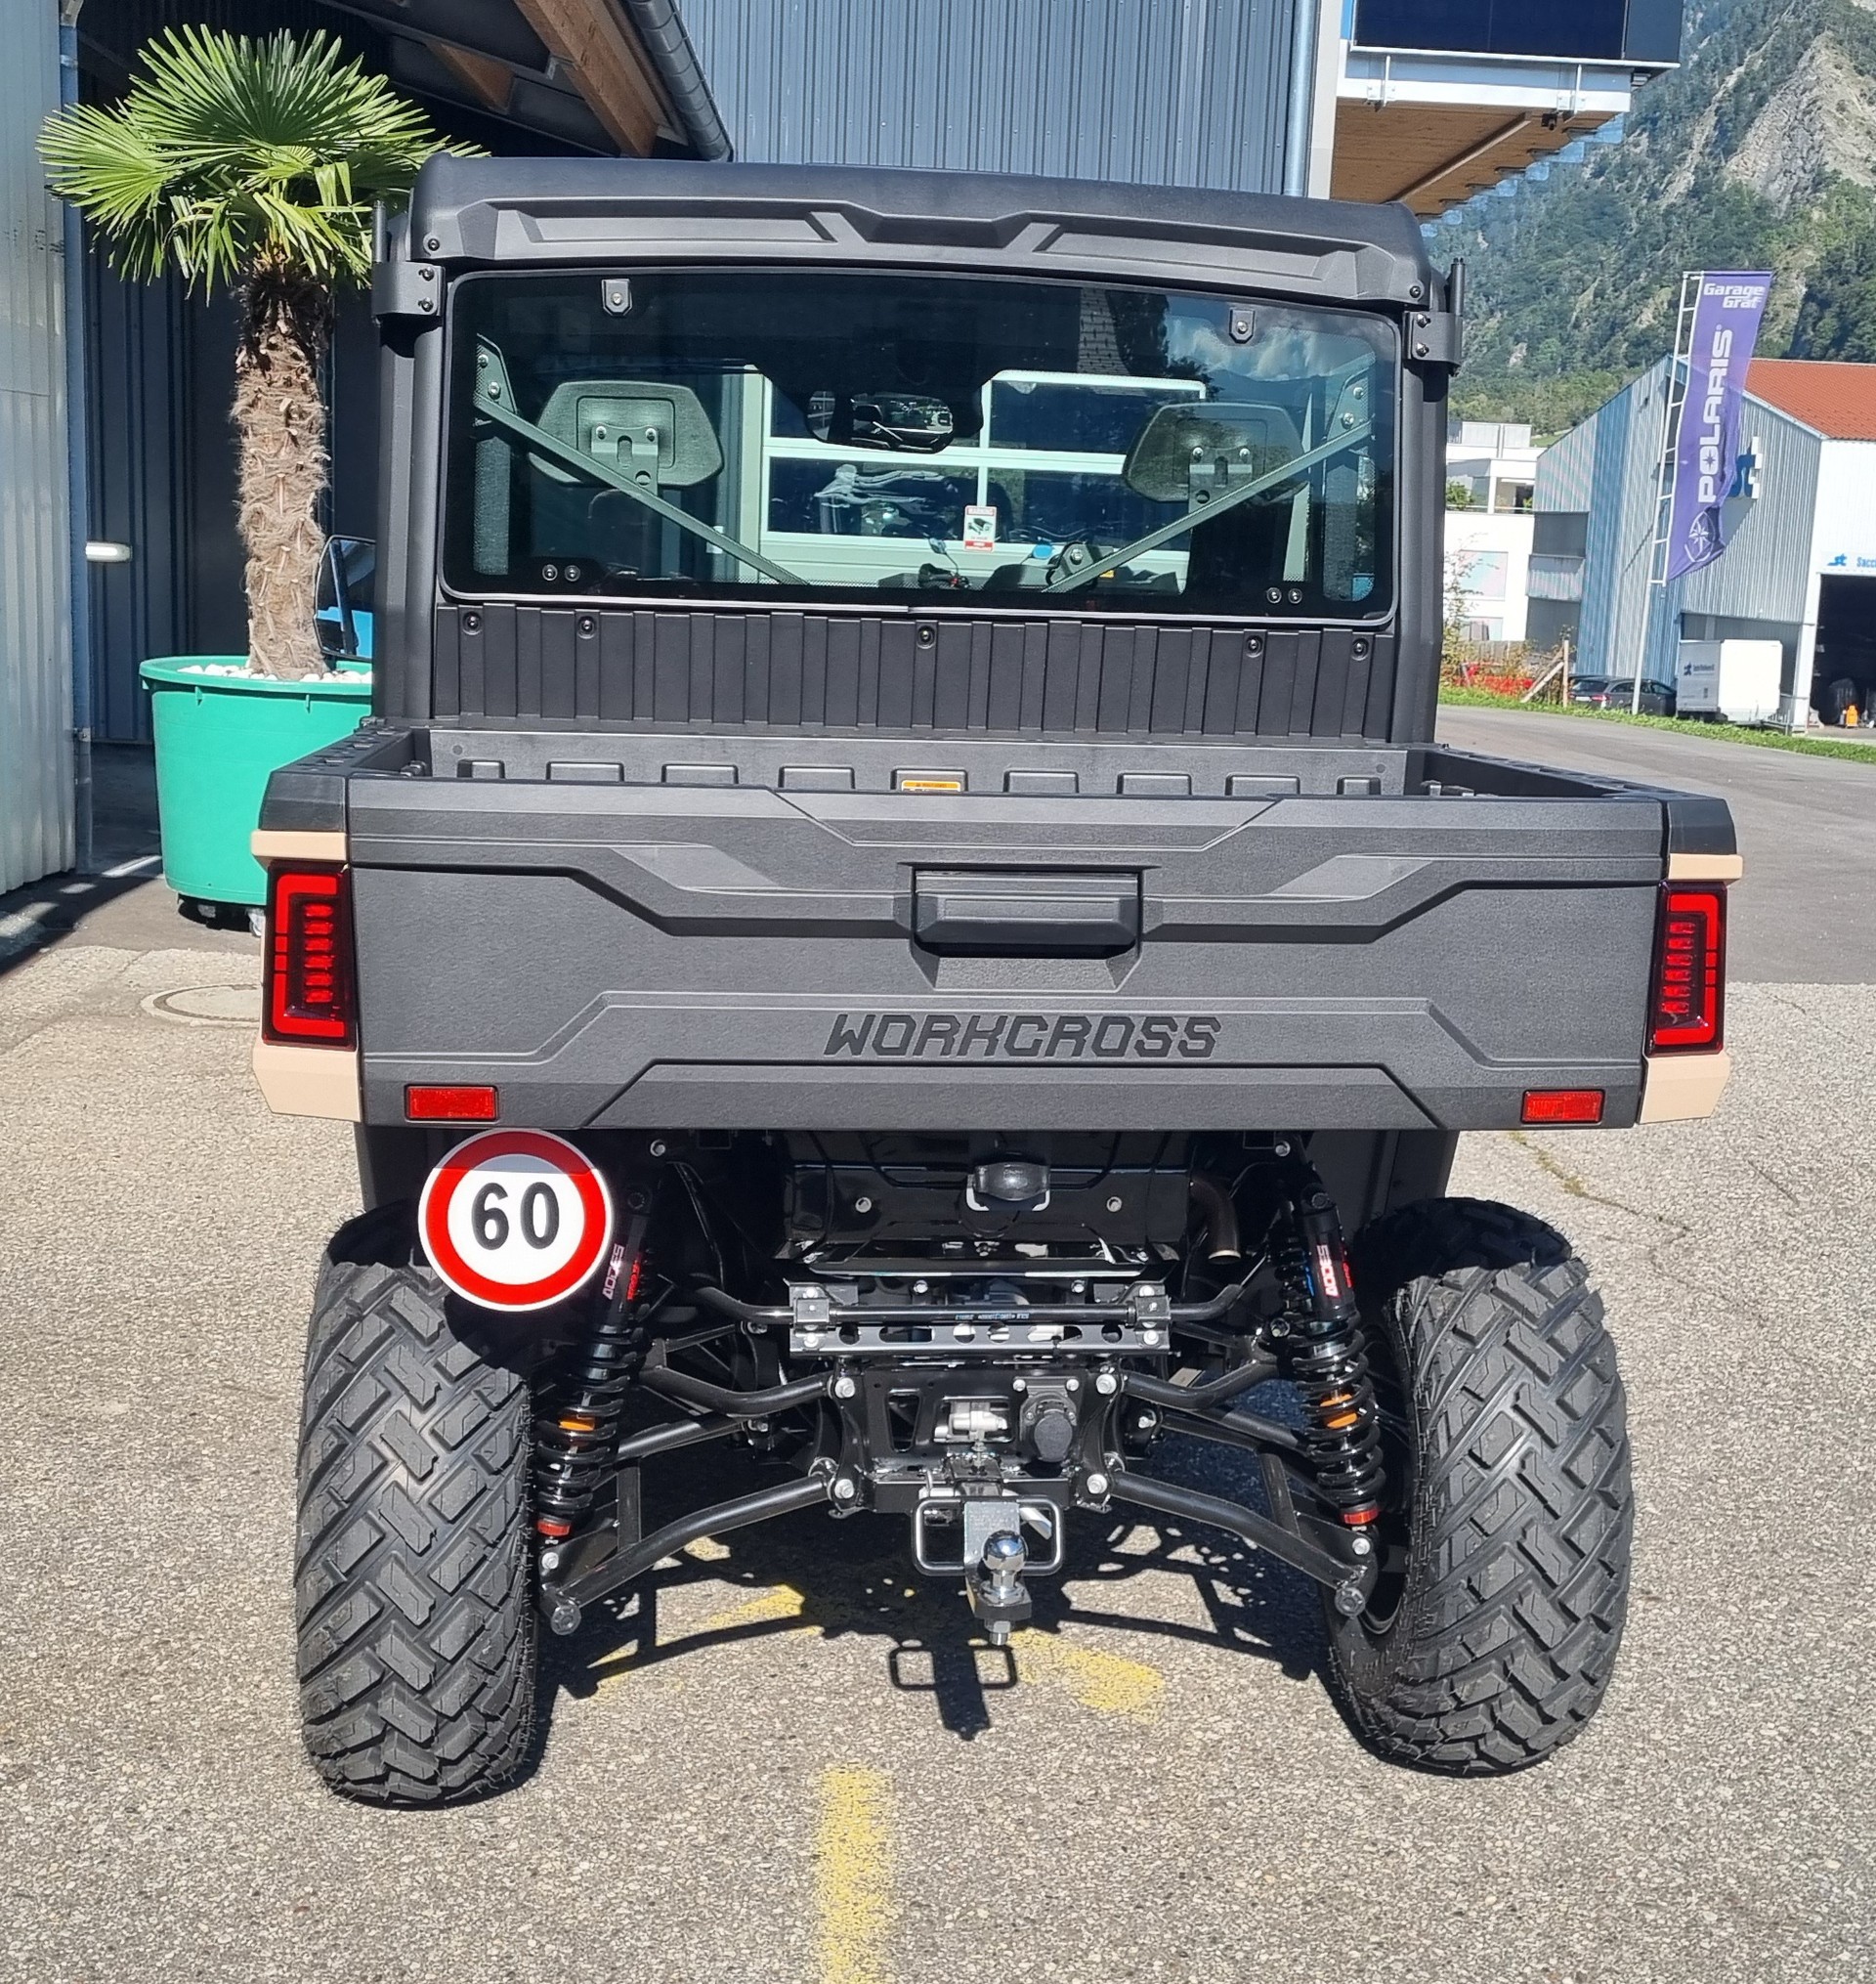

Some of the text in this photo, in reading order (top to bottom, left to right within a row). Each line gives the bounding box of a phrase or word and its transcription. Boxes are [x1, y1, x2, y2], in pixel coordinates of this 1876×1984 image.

[1703, 283, 1766, 297] Garage
[1723, 295, 1761, 309] Graf
[1698, 328, 1733, 503] POLARIS
[823, 1014, 1222, 1058] WORKCROSS
[471, 1182, 560, 1251] 60
